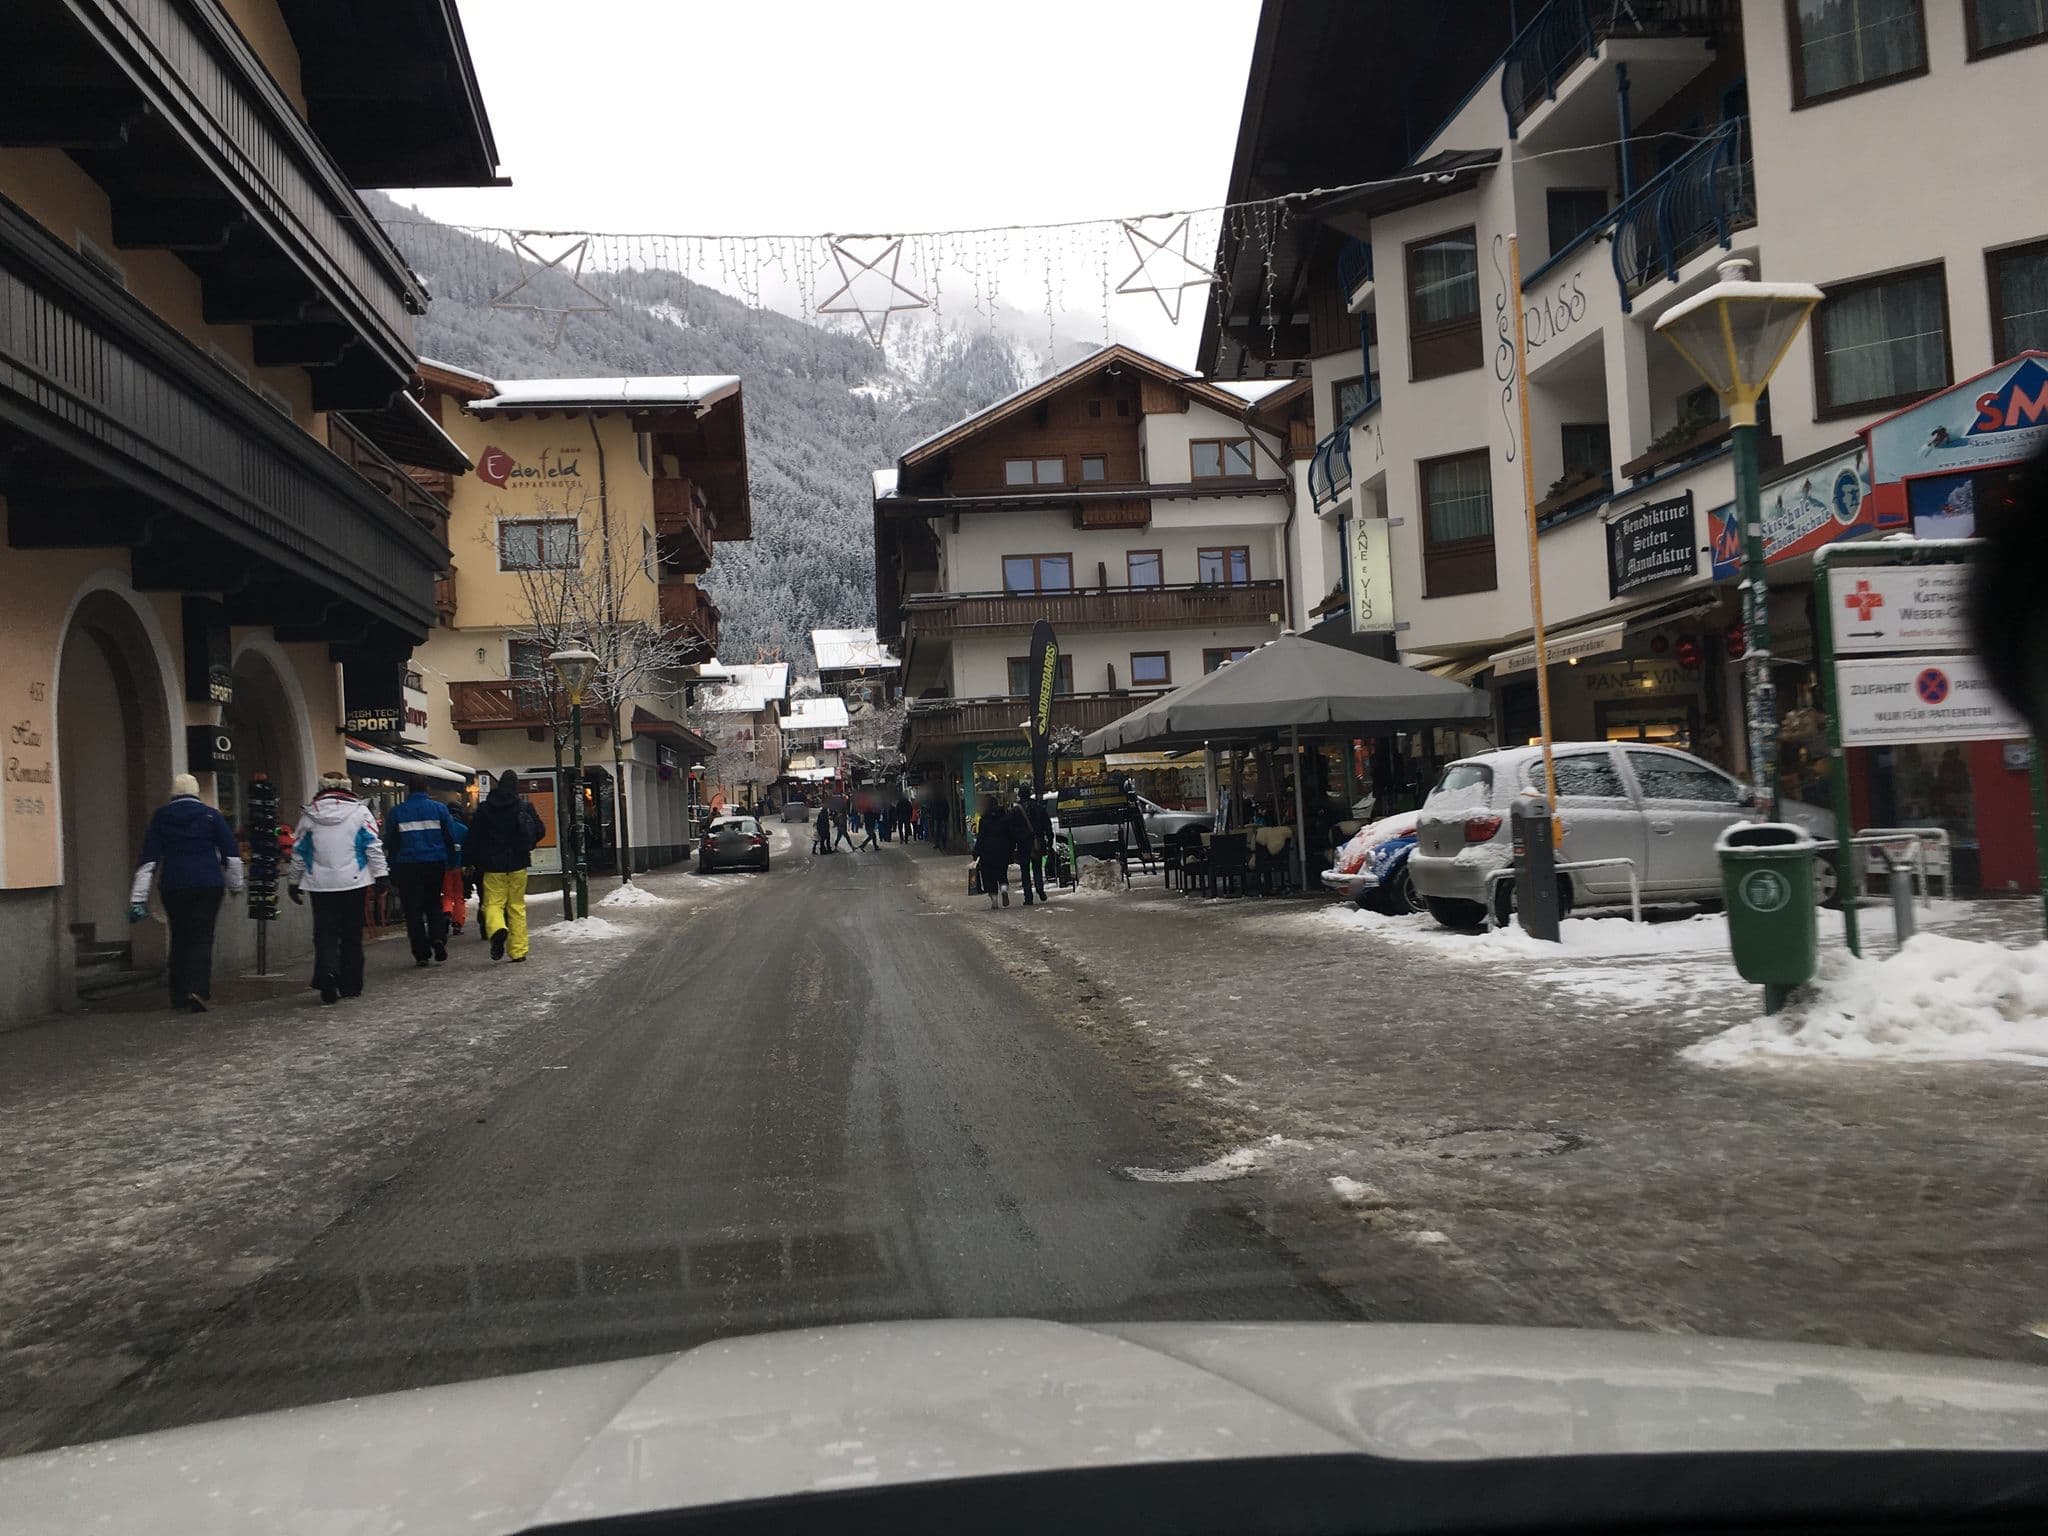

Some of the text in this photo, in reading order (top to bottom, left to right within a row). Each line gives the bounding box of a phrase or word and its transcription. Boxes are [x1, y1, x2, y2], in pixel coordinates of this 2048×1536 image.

[487, 447, 581, 479] Edenfeld
[1358, 520, 1369, 561] PANE
[1628, 547, 1692, 577] Manufaktur
[1361, 578, 1373, 620] VINO
[1038, 644, 1057, 719] MOREBOARDS
[347, 717, 399, 732] SPORT
[373, 708, 399, 717] TECH
